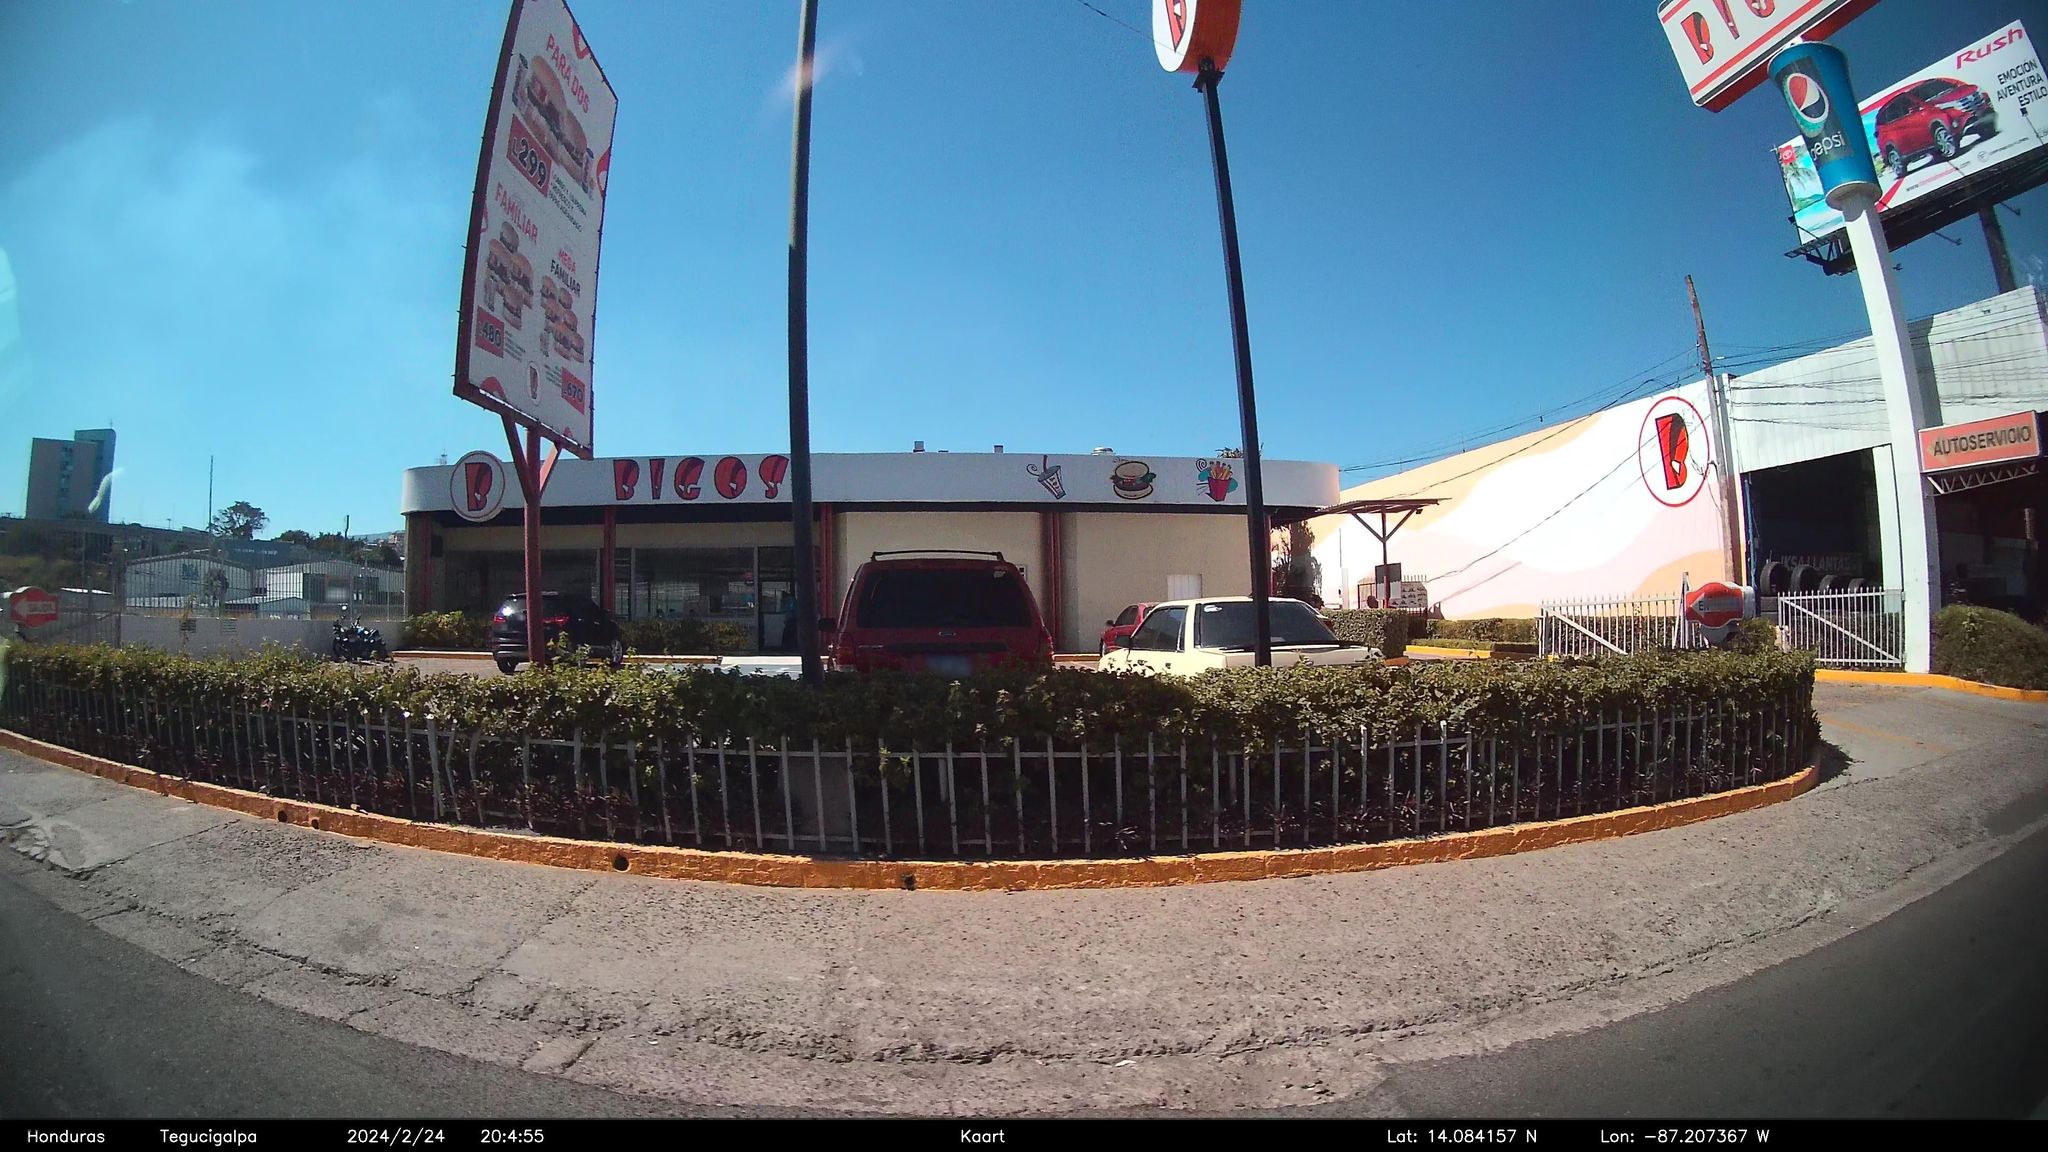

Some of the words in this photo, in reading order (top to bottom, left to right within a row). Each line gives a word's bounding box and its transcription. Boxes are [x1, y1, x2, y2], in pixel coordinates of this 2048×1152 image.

[1956, 28, 2023, 70] Rush
[546, 33, 571, 86] PARA
[571, 75, 589, 114] DOS
[1996, 73, 2044, 102] AVENTURA
[2018, 86, 2048, 107] ESTILO
[495, 182, 538, 245] FAMILIAR
[550, 258, 581, 297] FAMILIAR
[1933, 425, 2032, 457] AUTOSERVICIO
[613, 455, 790, 500] BIGOS
